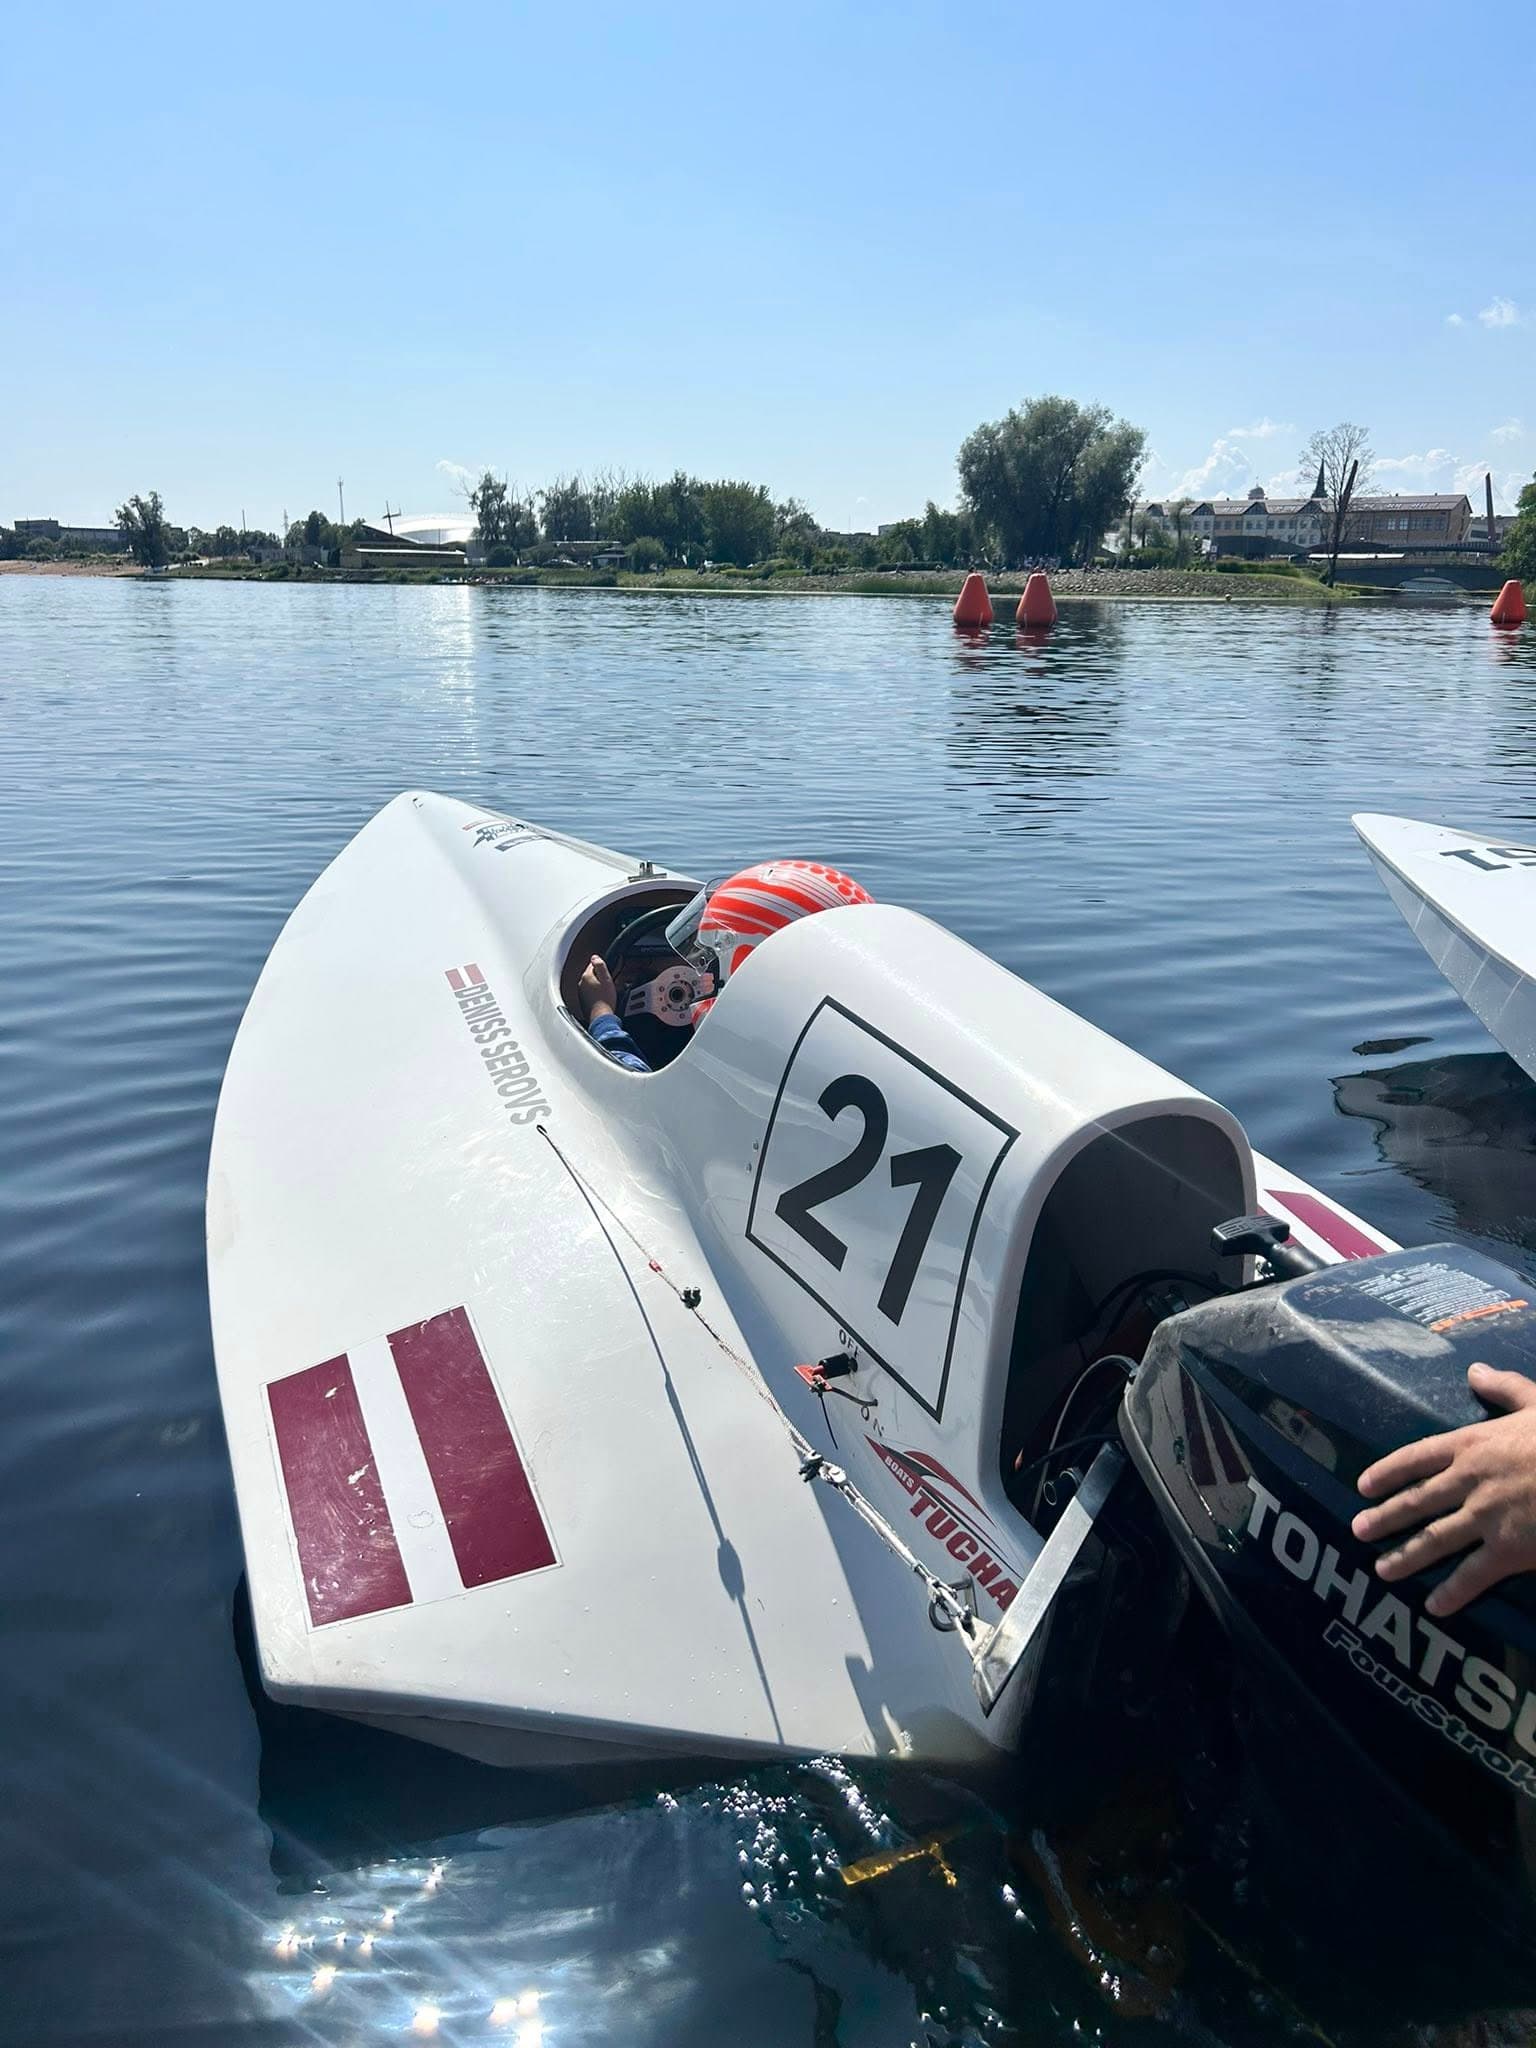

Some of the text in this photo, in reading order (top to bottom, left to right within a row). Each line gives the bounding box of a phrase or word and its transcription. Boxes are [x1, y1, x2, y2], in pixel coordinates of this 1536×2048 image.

[454, 981, 552, 1126] DENISS SEROVS
[775, 1073, 963, 1327] 21
[884, 1455, 915, 1488] BOATS
[908, 1489, 1020, 1611] TUCHA
